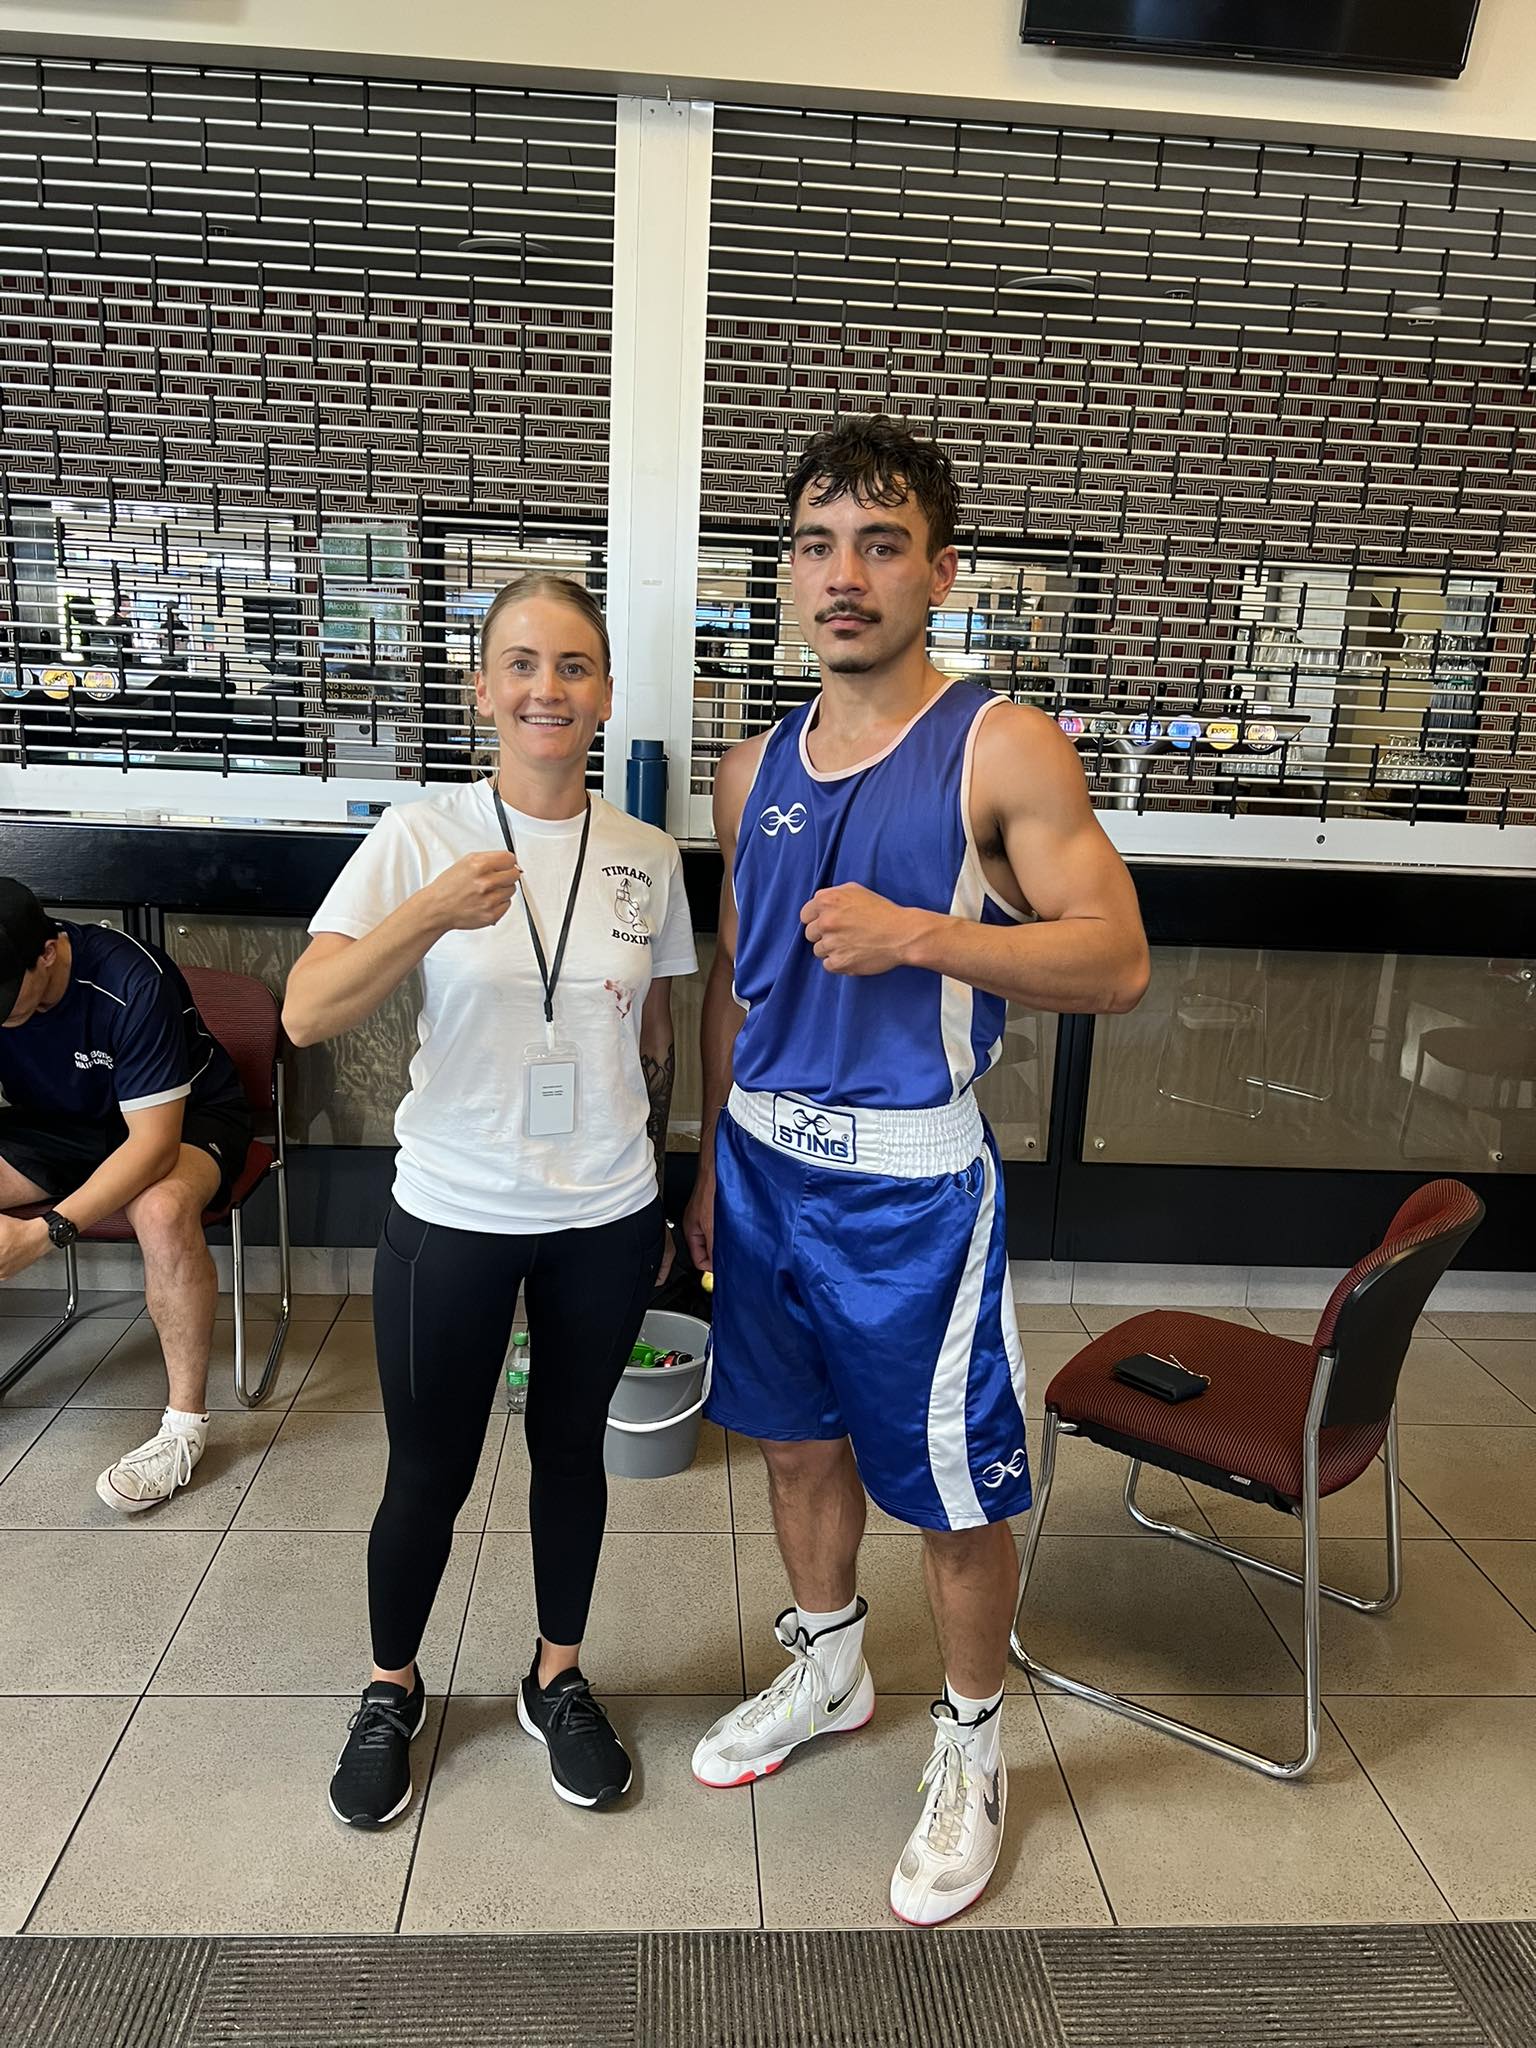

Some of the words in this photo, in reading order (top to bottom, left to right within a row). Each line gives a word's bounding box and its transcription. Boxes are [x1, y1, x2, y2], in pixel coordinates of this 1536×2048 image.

[328, 601, 356, 611] Alcohol
[326, 672, 339, 680] No
[340, 672, 351, 680] ID
[341, 683, 374, 691] Service
[326, 691, 339, 699] No
[341, 692, 390, 701] Exceptions
[1134, 723, 1158, 736] BLK
[602, 866, 653, 887] TIMARU
[611, 929, 649, 945] BOXIN
[779, 1125, 849, 1158] STING
